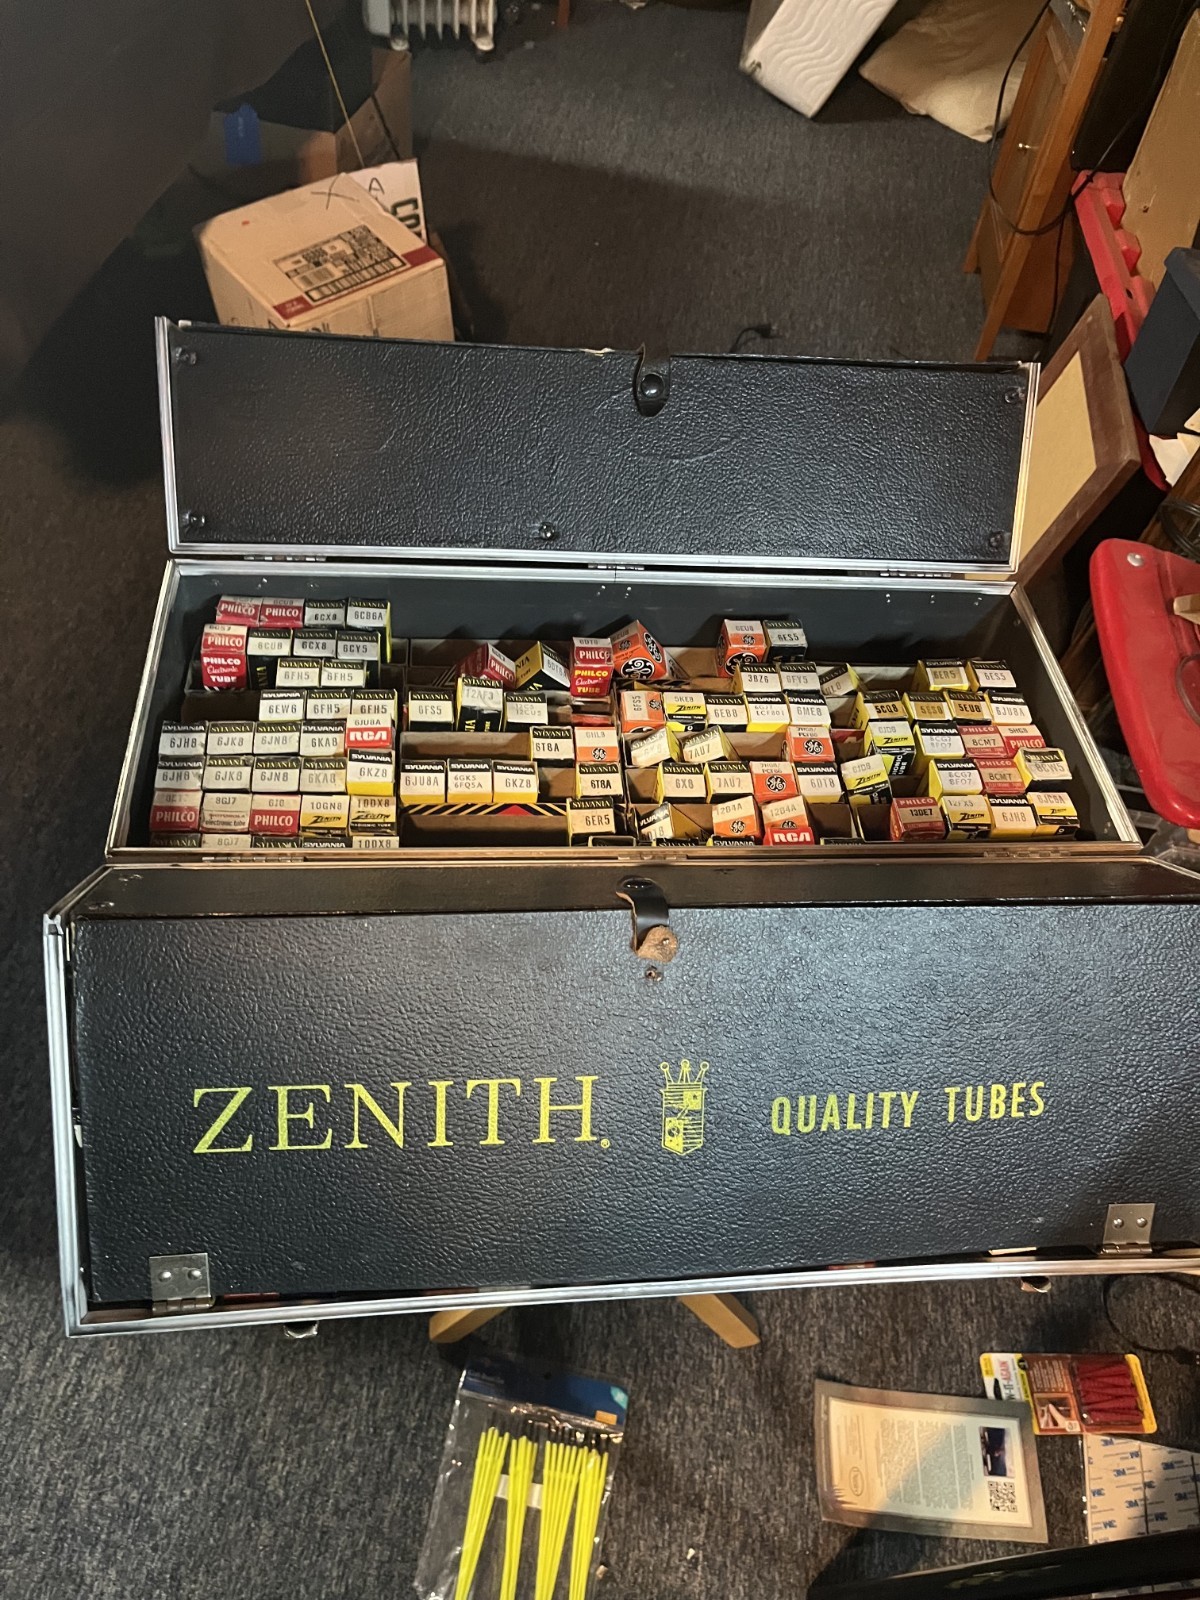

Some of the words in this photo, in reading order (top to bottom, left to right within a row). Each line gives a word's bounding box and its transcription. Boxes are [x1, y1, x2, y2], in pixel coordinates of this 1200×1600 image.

[220, 604, 256, 616] PHILCO
[265, 608, 299, 619] PHILCO
[207, 637, 243, 648] PHILCO
[301, 642, 327, 651] 6CX8
[343, 645, 368, 654] 6CY5
[579, 651, 609, 660] PHILCO
[202, 657, 242, 665] PHILCO
[490, 660, 515, 681] PHILCO
[934, 671, 957, 680] 6ER5
[284, 672, 311, 681] 6FH5
[327, 673, 354, 682] 6FH5
[748, 675, 770, 684] 3BZ6
[984, 671, 1008, 681] 6ES5
[463, 679, 501, 689] SYLVANIA
[268, 705, 298, 714] 6EW6
[313, 704, 341, 714] 6FH5
[360, 705, 388, 715] 6FH5
[417, 705, 442, 715] 6FS5
[673, 705, 702, 713] ZENITH
[796, 708, 823, 717] 6ME8
[875, 704, 899, 714] 5CQ8
[261, 736, 289, 745] 6JN8
[349, 731, 389, 741] RCA
[168, 738, 198, 749] 6JH8
[216, 737, 245, 747] 6JK8
[311, 737, 339, 748] 6KA8
[1010, 740, 1043, 751] PHILCO
[535, 743, 561, 753] 6T8A
[351, 754, 391, 763] SYLVANIA
[359, 768, 388, 778] 6KZ8
[496, 765, 534, 773] SYLVANIA
[579, 766, 617, 774] SYLVANIA
[663, 766, 701, 774] SYLVANIA
[709, 764, 748, 772] SYLVANIA
[1036, 764, 1065, 773] 8CW5
[214, 771, 243, 781] 6JK8
[260, 772, 289, 782] 6JN8
[308, 774, 337, 783] 6KA8
[405, 777, 440, 787] 6JU8A
[505, 780, 532, 789] 6KZ8
[590, 779, 613, 790] 6T8A
[675, 779, 695, 790] 6X8
[717, 778, 742, 788] 7AU7
[810, 779, 836, 789] 6DT8
[215, 797, 238, 805] 8GJ7
[357, 799, 391, 808] 10DX8
[571, 801, 610, 809] SYLVANIA
[155, 811, 196, 823] PHILCO
[254, 815, 294, 826] PHILCO
[308, 816, 342, 825] ZENITH
[585, 815, 611, 827] 6ER5
[958, 812, 986, 822] ZENITH
[1001, 812, 1028, 823] 6JH8
[772, 832, 812, 843] RCA
[771, 1091, 920, 1136] QUALITY
[944, 1081, 1046, 1124] TUBES
[193, 1075, 599, 1154] ZENITH
